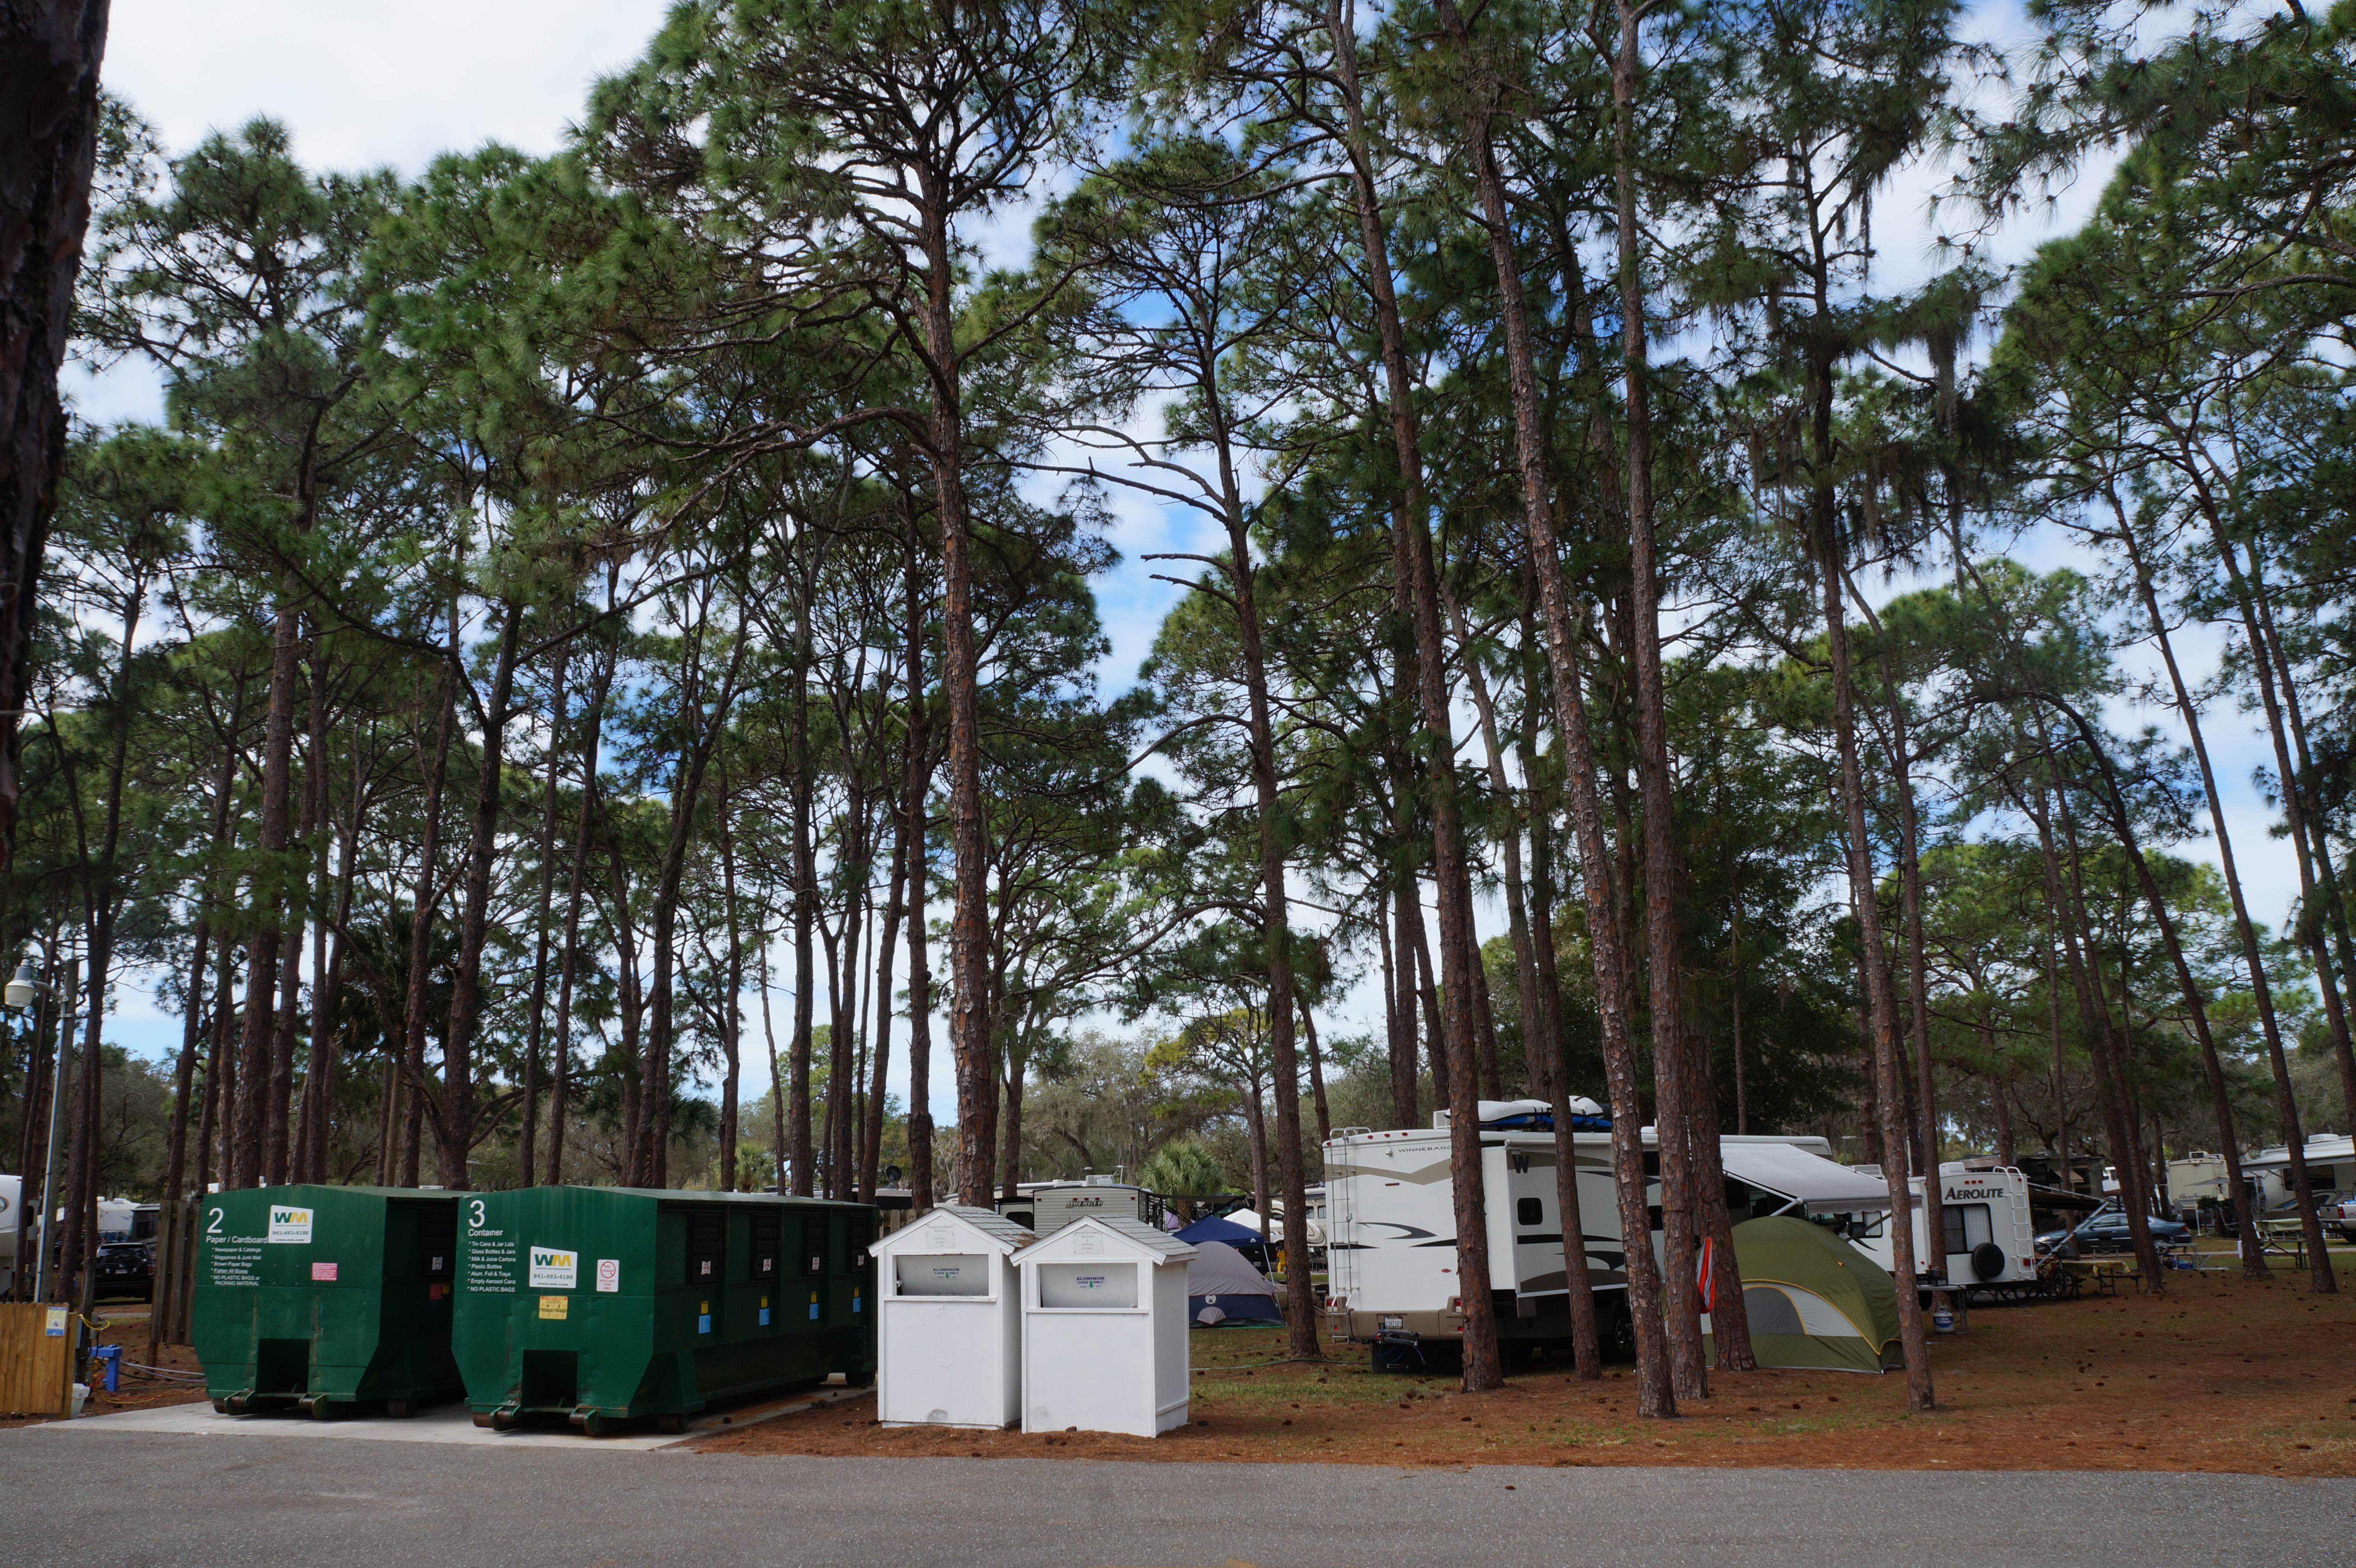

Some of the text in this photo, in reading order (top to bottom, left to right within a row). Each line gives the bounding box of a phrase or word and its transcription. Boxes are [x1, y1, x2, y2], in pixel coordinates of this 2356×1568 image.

[1512, 1155, 1529, 1173] W
[207, 1208, 224, 1233] 2
[274, 1212, 308, 1223] WM
[469, 1200, 485, 1227] 3
[206, 1236, 227, 1244] Paper
[535, 1254, 572, 1266] WM
